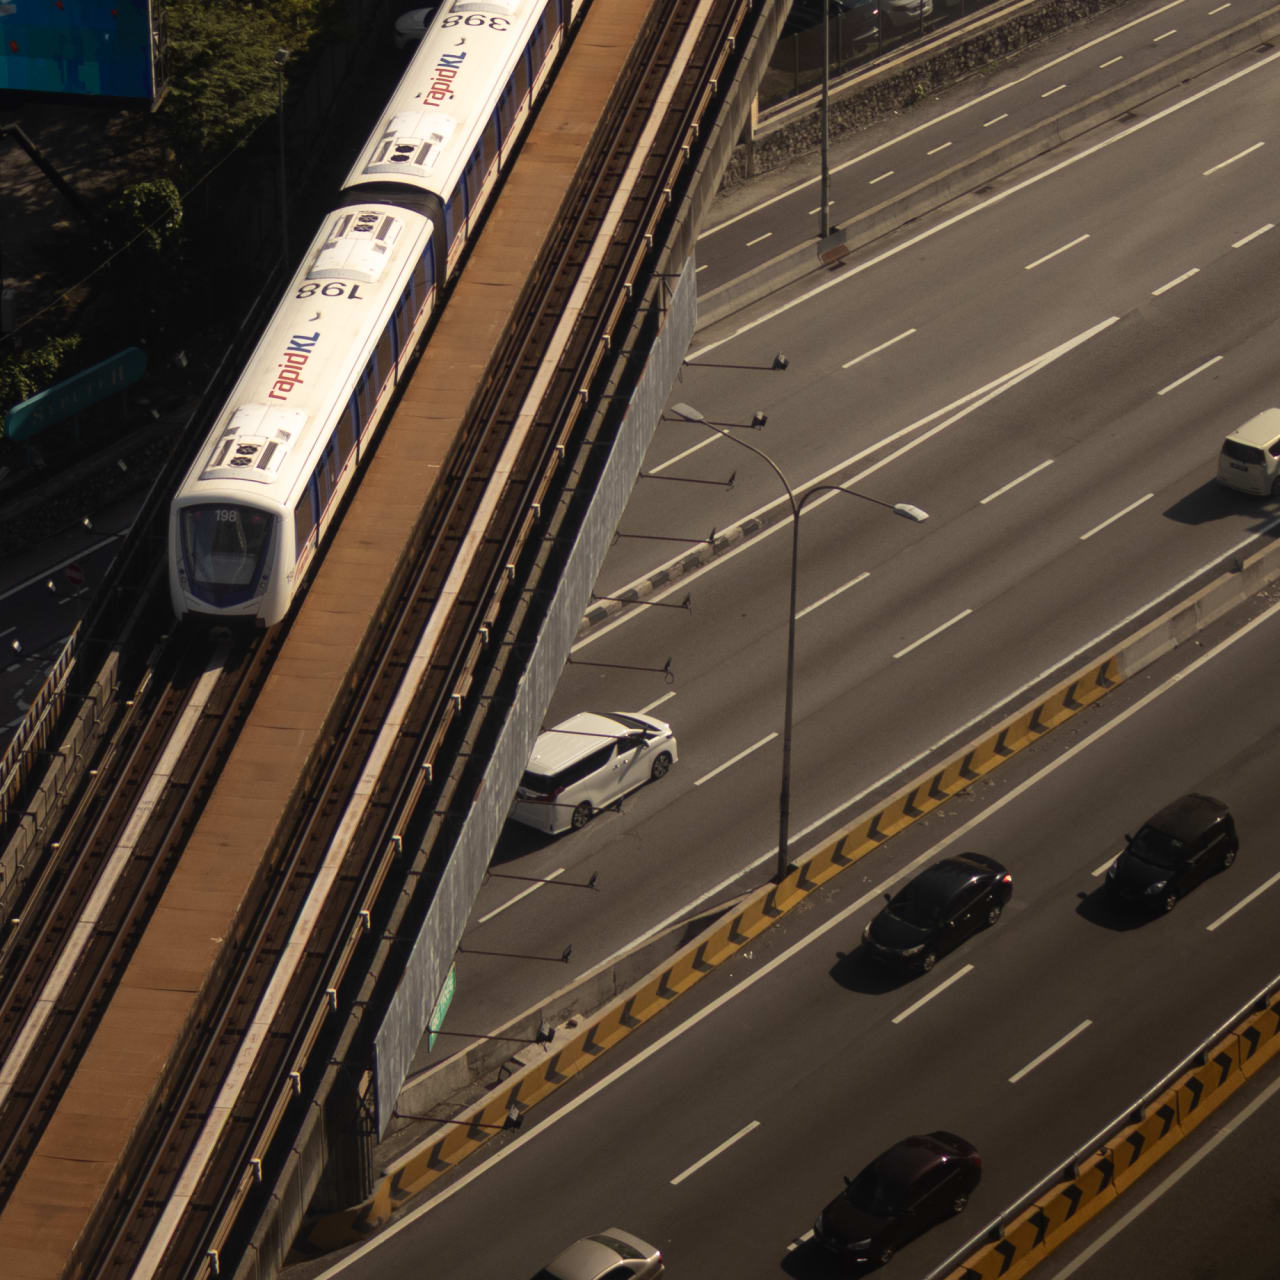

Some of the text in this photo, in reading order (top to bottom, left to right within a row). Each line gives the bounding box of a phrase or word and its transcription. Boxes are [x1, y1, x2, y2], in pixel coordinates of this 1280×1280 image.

[441, 13, 511, 32] 398
[423, 51, 467, 108] rapidKL
[294, 282, 364, 301] 198
[268, 331, 321, 402] rapidKL
[215, 509, 238, 523] 198
